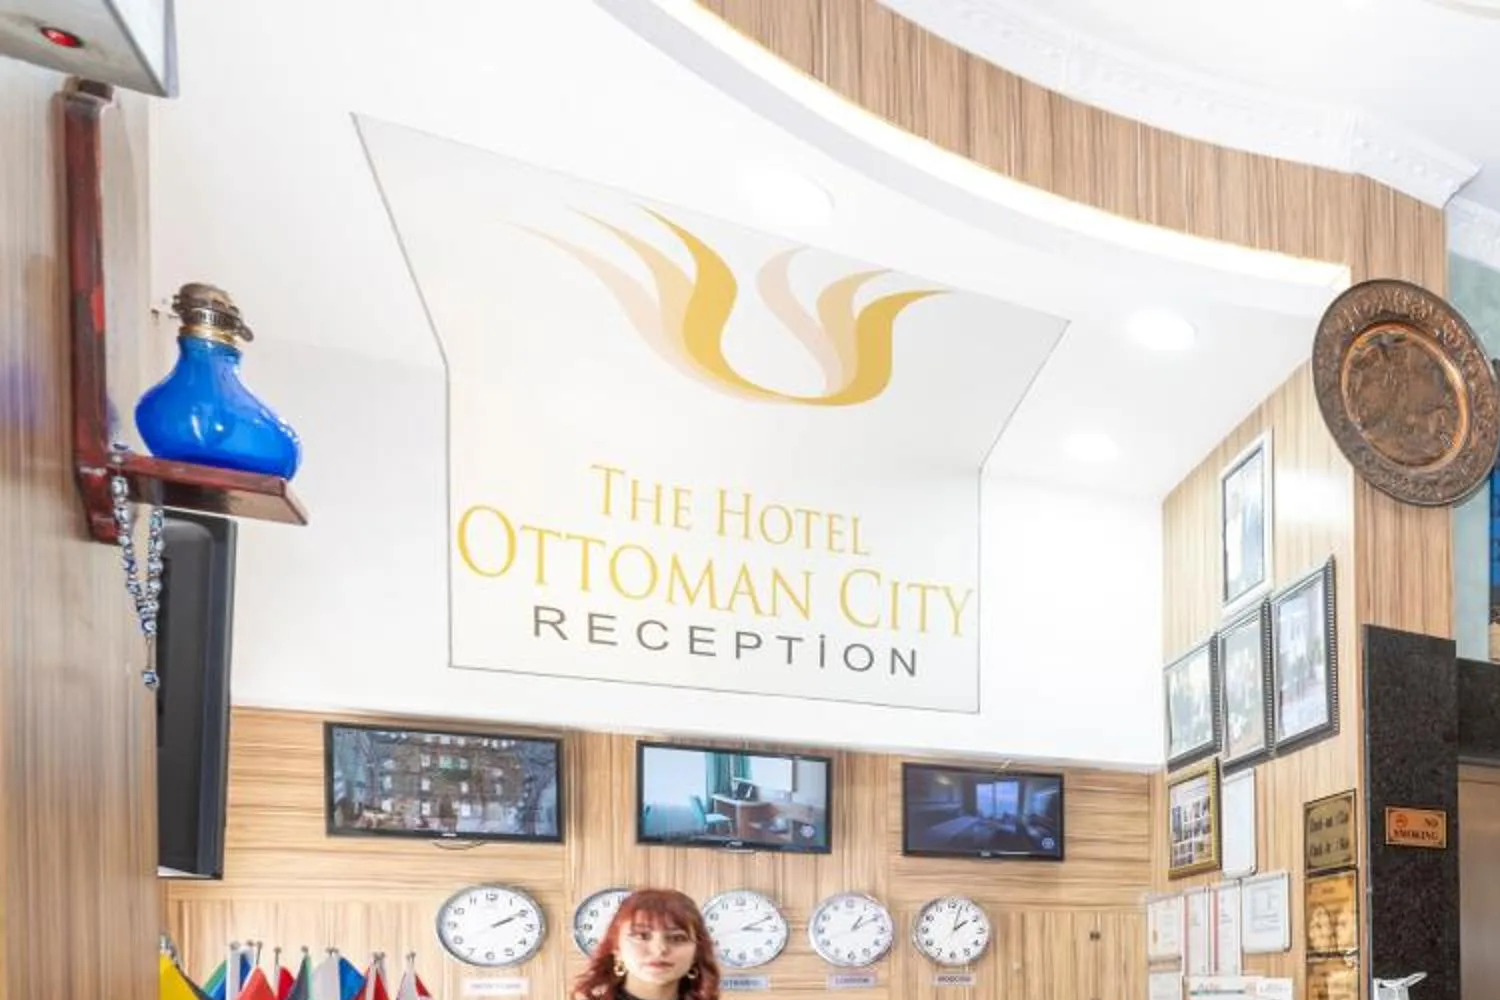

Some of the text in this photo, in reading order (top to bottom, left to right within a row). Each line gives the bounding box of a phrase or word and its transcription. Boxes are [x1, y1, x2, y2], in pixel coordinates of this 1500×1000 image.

[591, 464, 870, 556] THE HOTEL
[457, 505, 974, 637] OTTOMAN CITY
